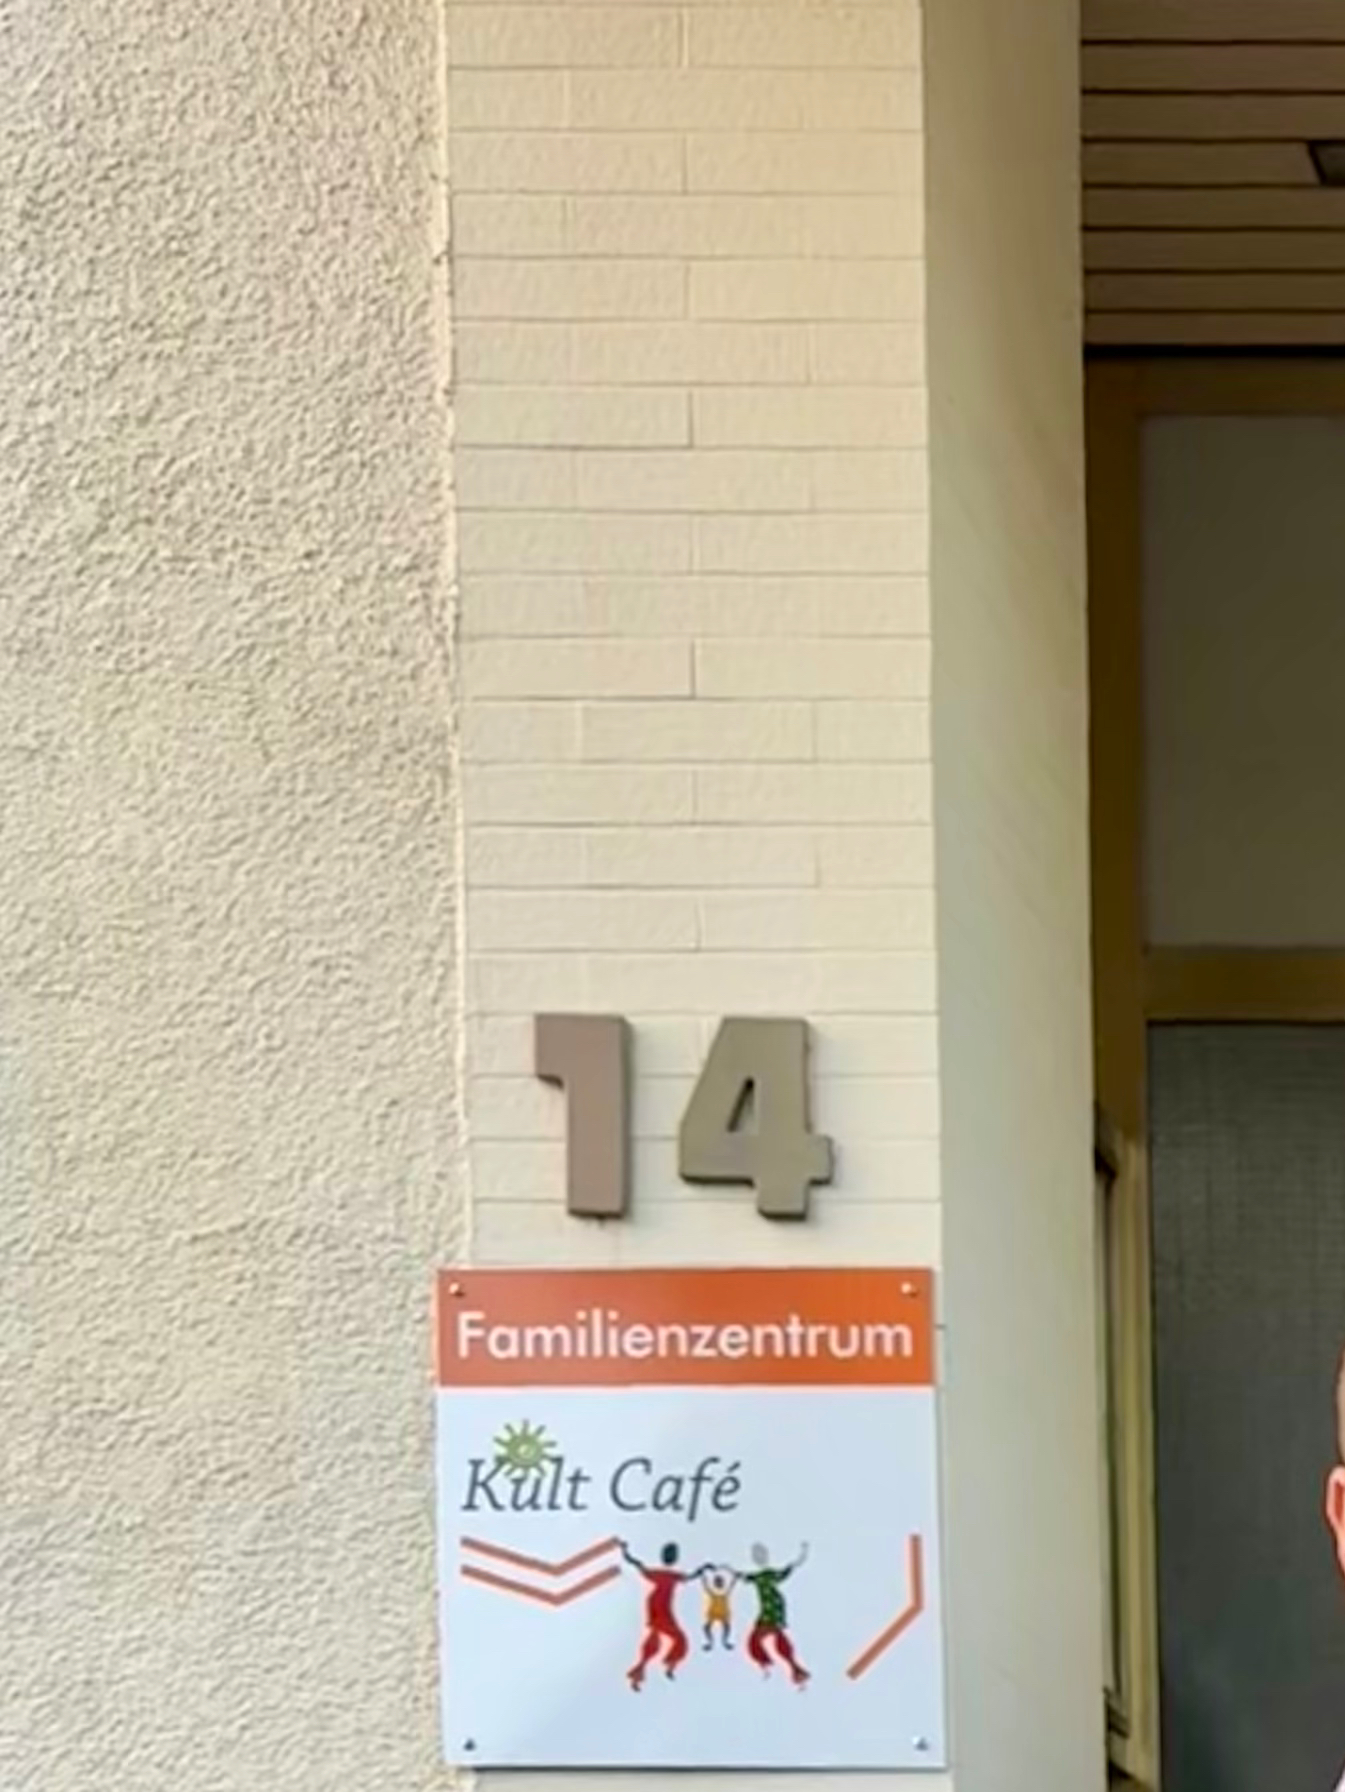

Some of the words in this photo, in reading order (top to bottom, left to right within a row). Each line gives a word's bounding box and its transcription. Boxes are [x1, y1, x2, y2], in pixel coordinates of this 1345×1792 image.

[535, 1013, 834, 1219] 14
[457, 1308, 913, 1358] Familienzentrum
[610, 1456, 741, 1522] Café
